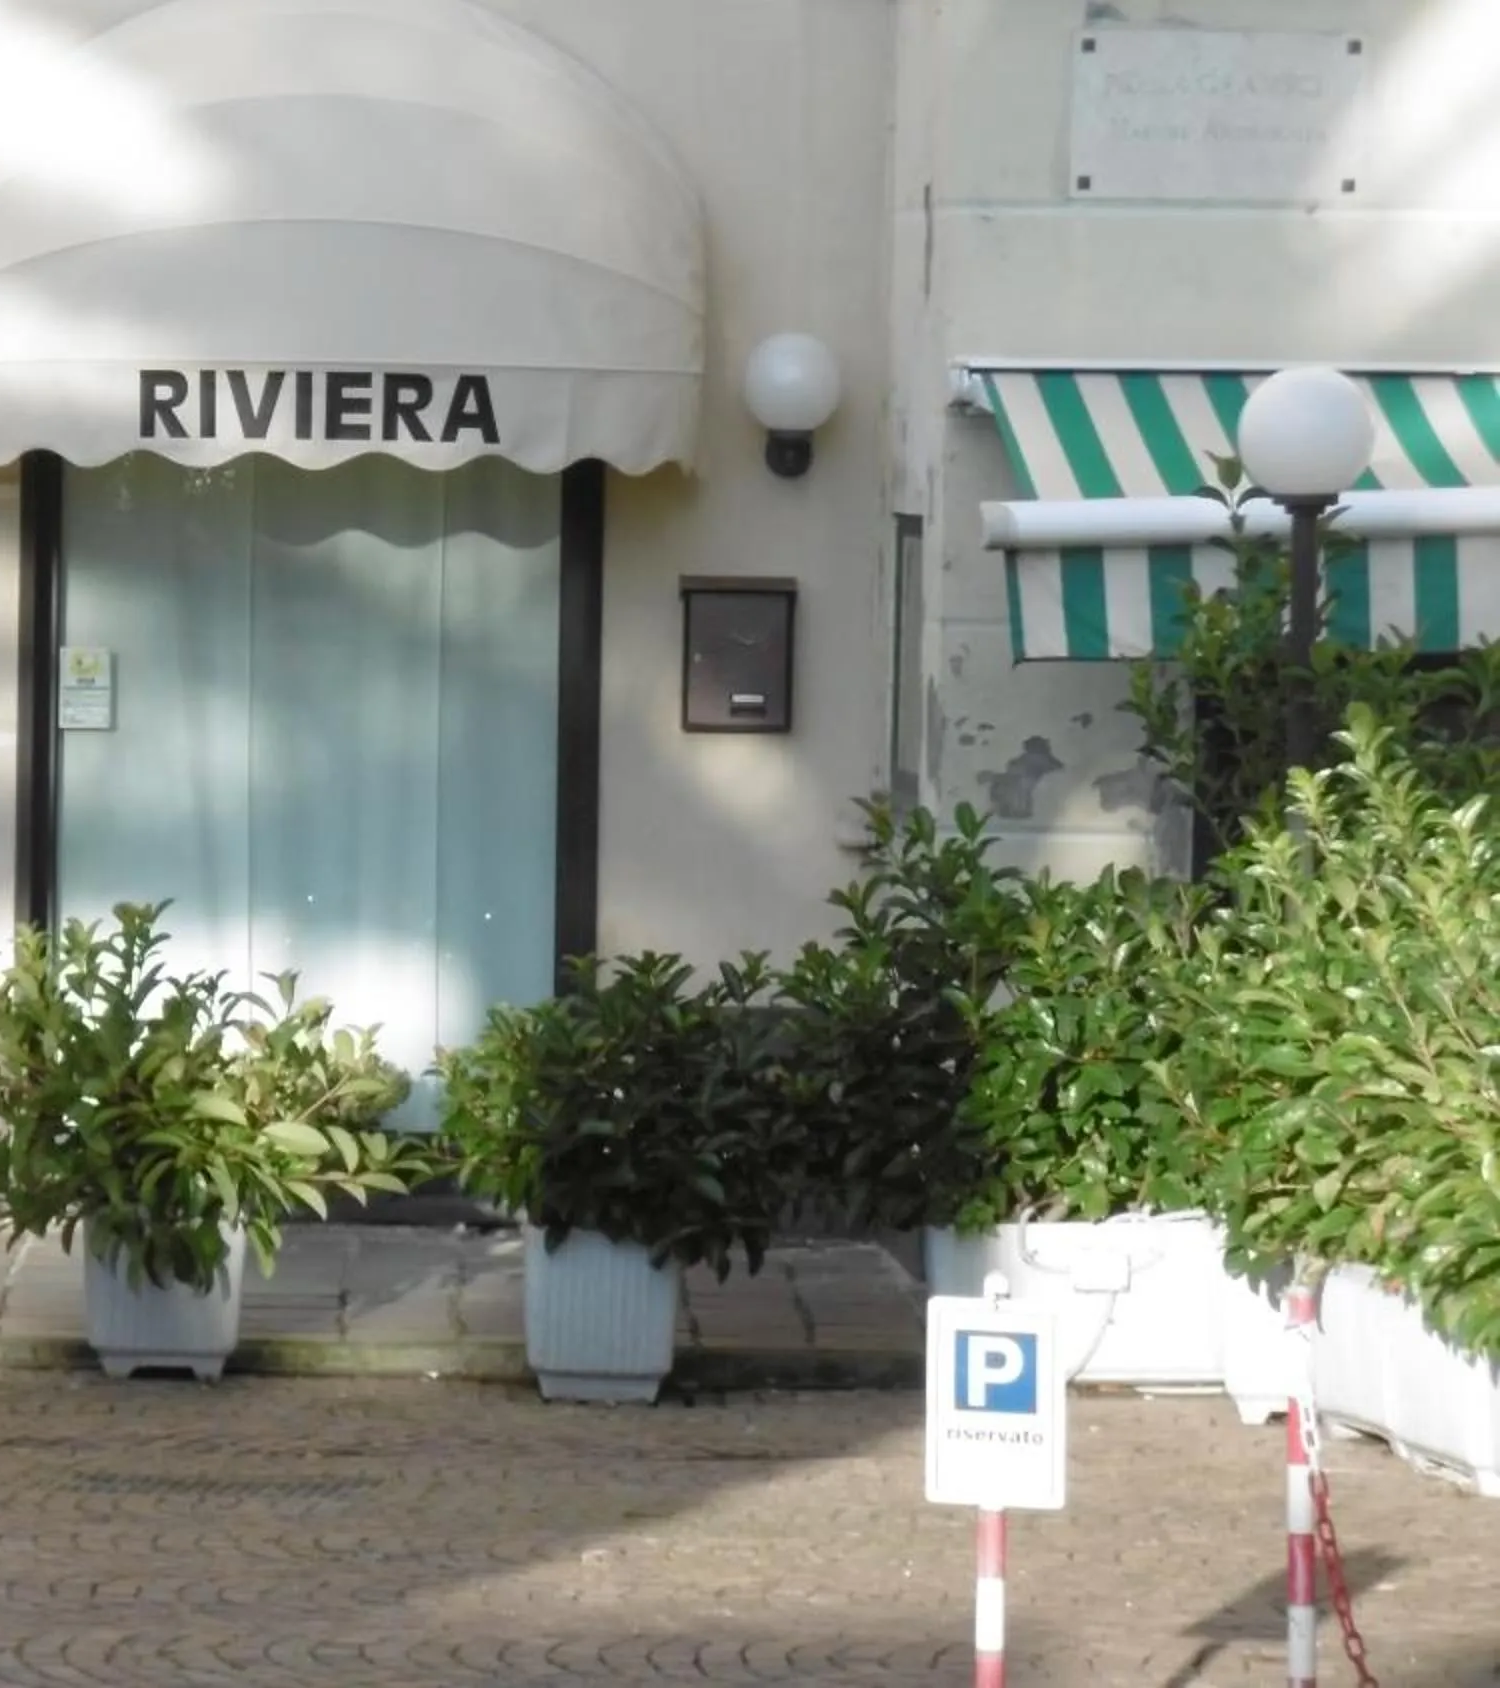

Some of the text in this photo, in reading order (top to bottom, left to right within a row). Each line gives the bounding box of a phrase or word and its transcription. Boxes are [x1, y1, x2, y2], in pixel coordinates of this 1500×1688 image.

[139, 369, 501, 444] RIVIERA
[967, 1335, 1024, 1407] P
[946, 1428, 1045, 1446] riservato
